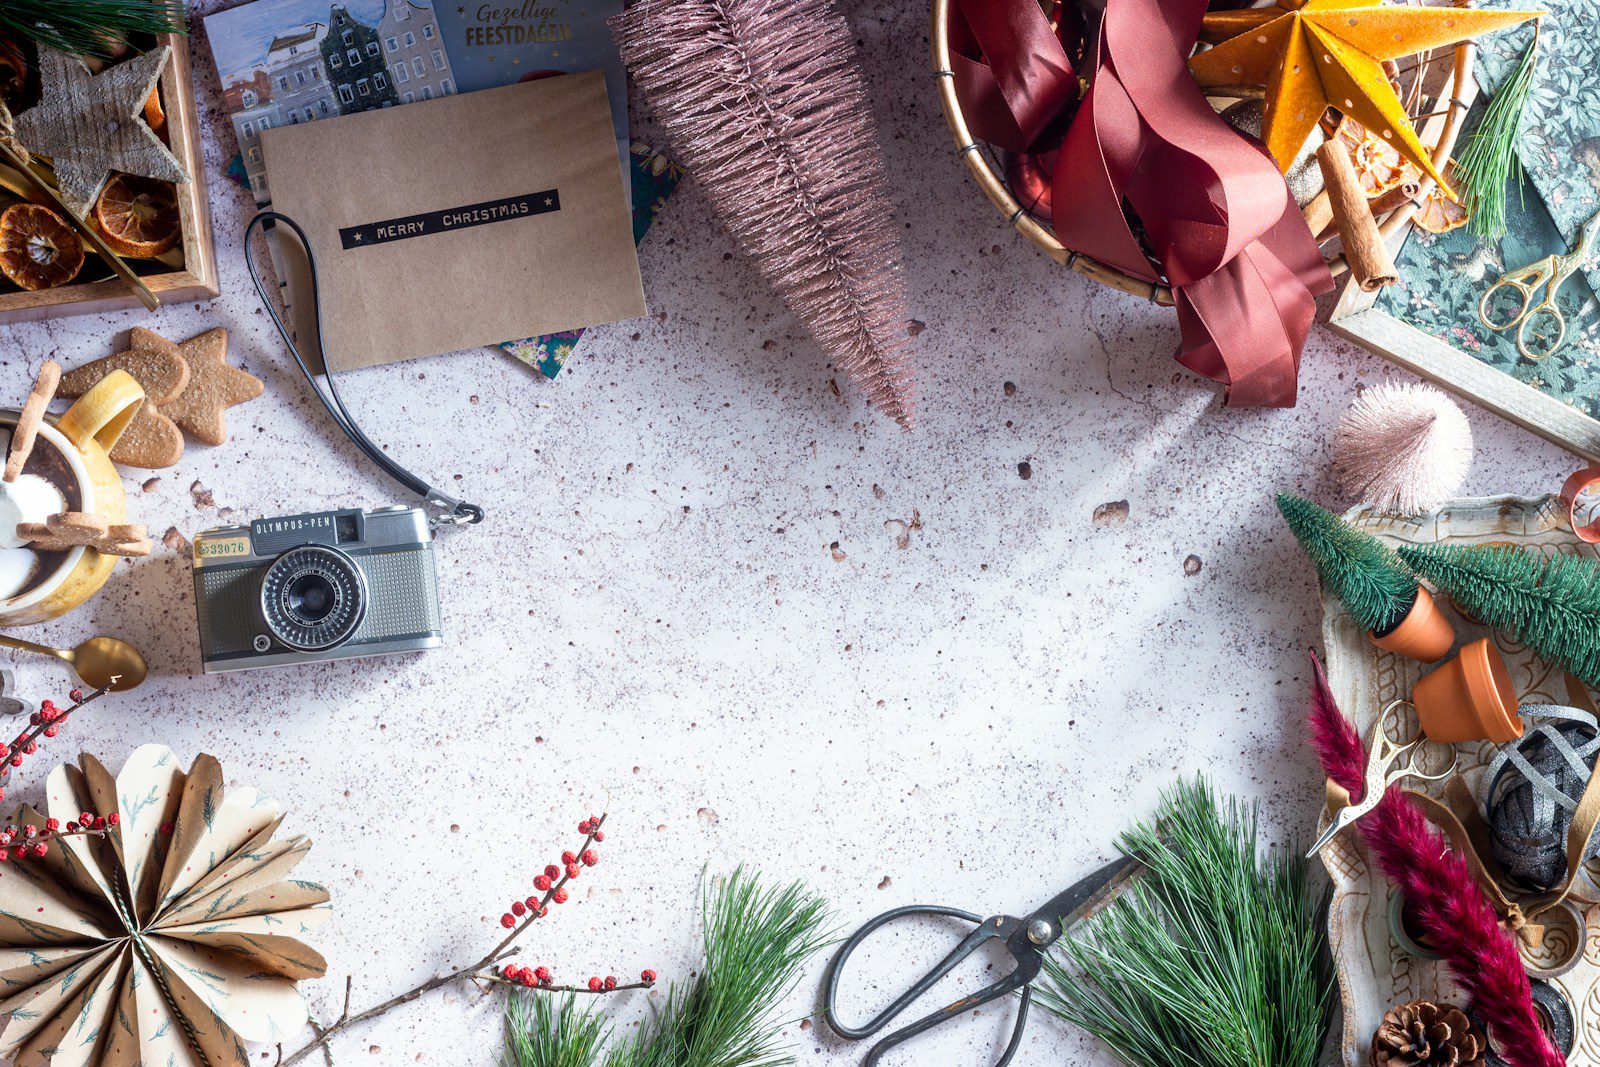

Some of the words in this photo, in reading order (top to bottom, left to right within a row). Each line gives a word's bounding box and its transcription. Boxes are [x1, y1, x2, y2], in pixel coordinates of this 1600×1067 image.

[476, 0, 559, 25] Gezellige
[465, 24, 571, 46] FEESTDAGEN
[376, 221, 425, 239] MERRY
[442, 202, 529, 226] CHRISTMAS
[256, 516, 330, 534] OLYMPUS-PEN
